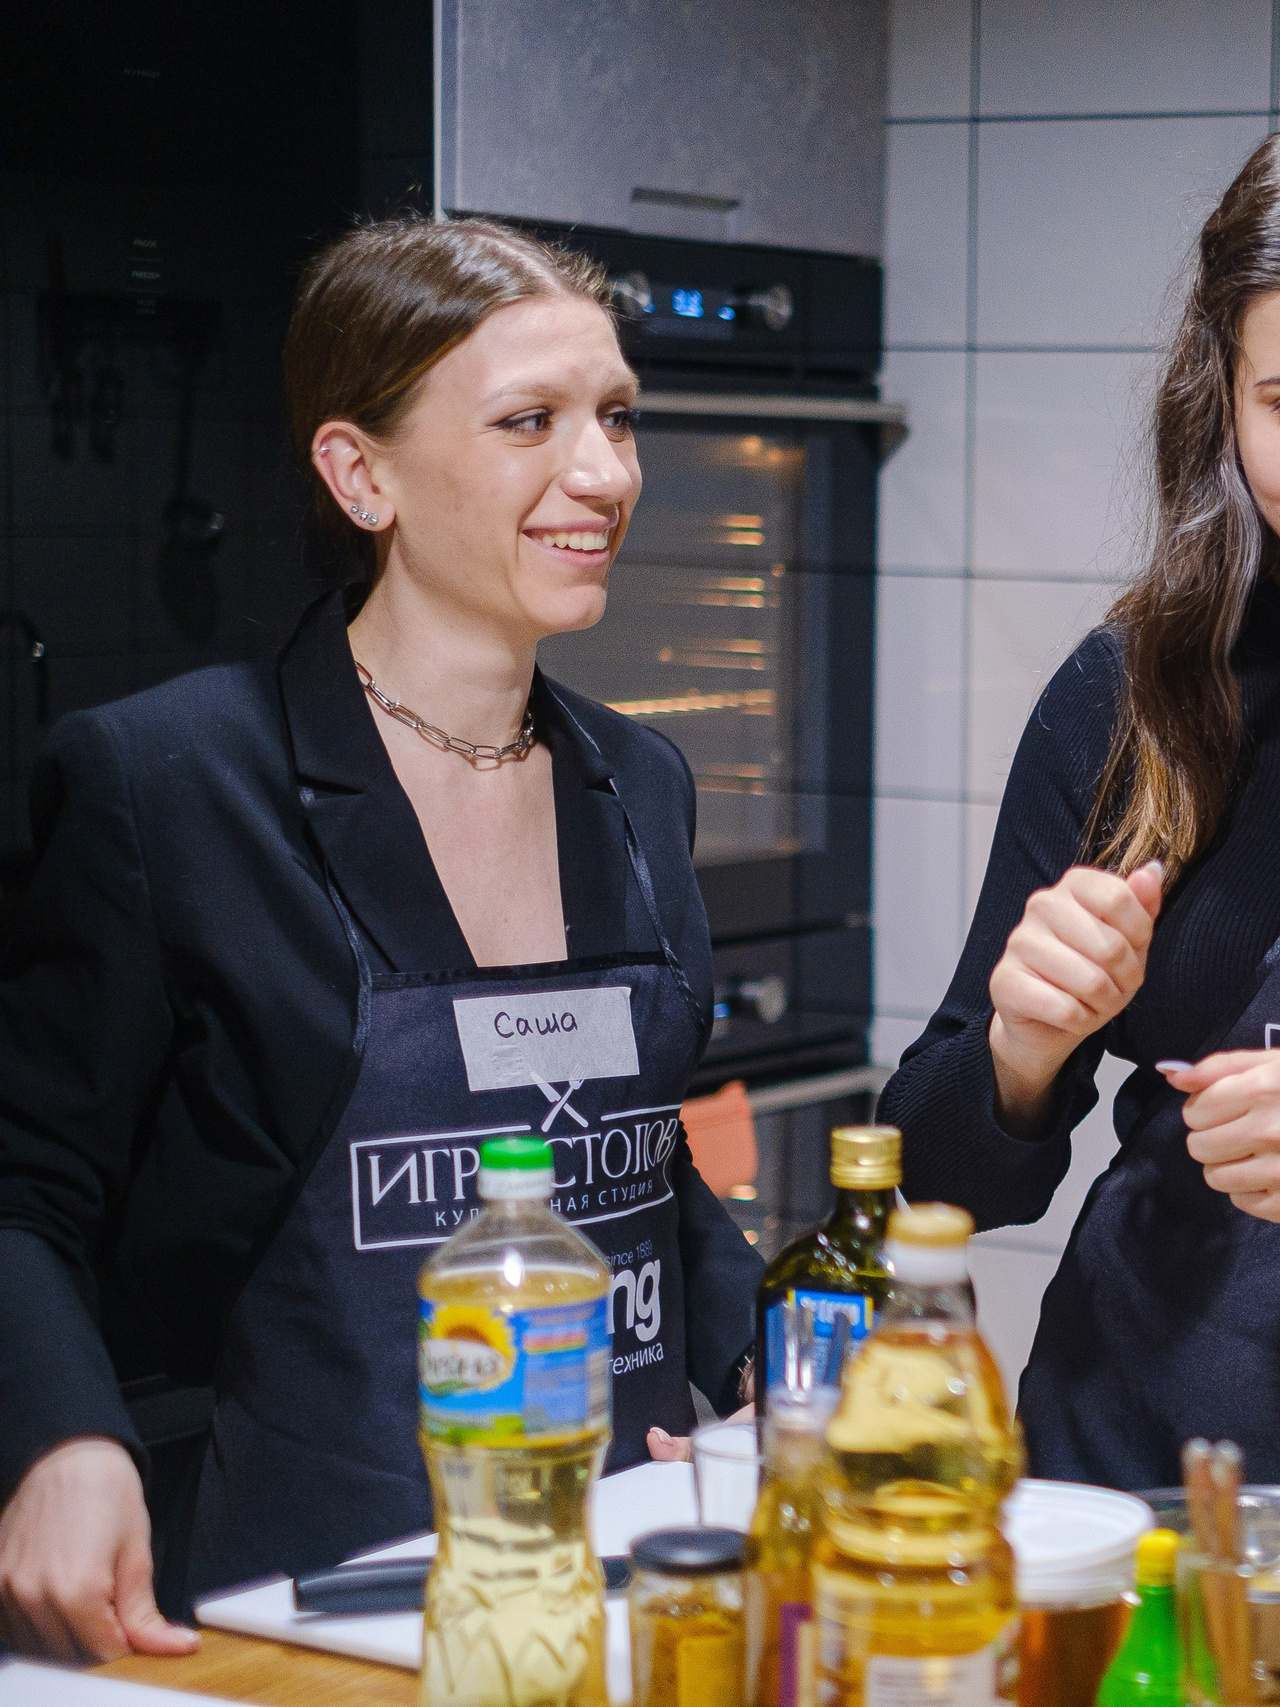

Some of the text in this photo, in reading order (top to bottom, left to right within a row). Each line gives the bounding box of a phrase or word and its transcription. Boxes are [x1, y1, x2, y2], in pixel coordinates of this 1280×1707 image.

[494, 1011, 578, 1039] Саша
[368, 1147, 481, 1207] ИГР
[598, 1179, 653, 1205] СТУДИЯ
